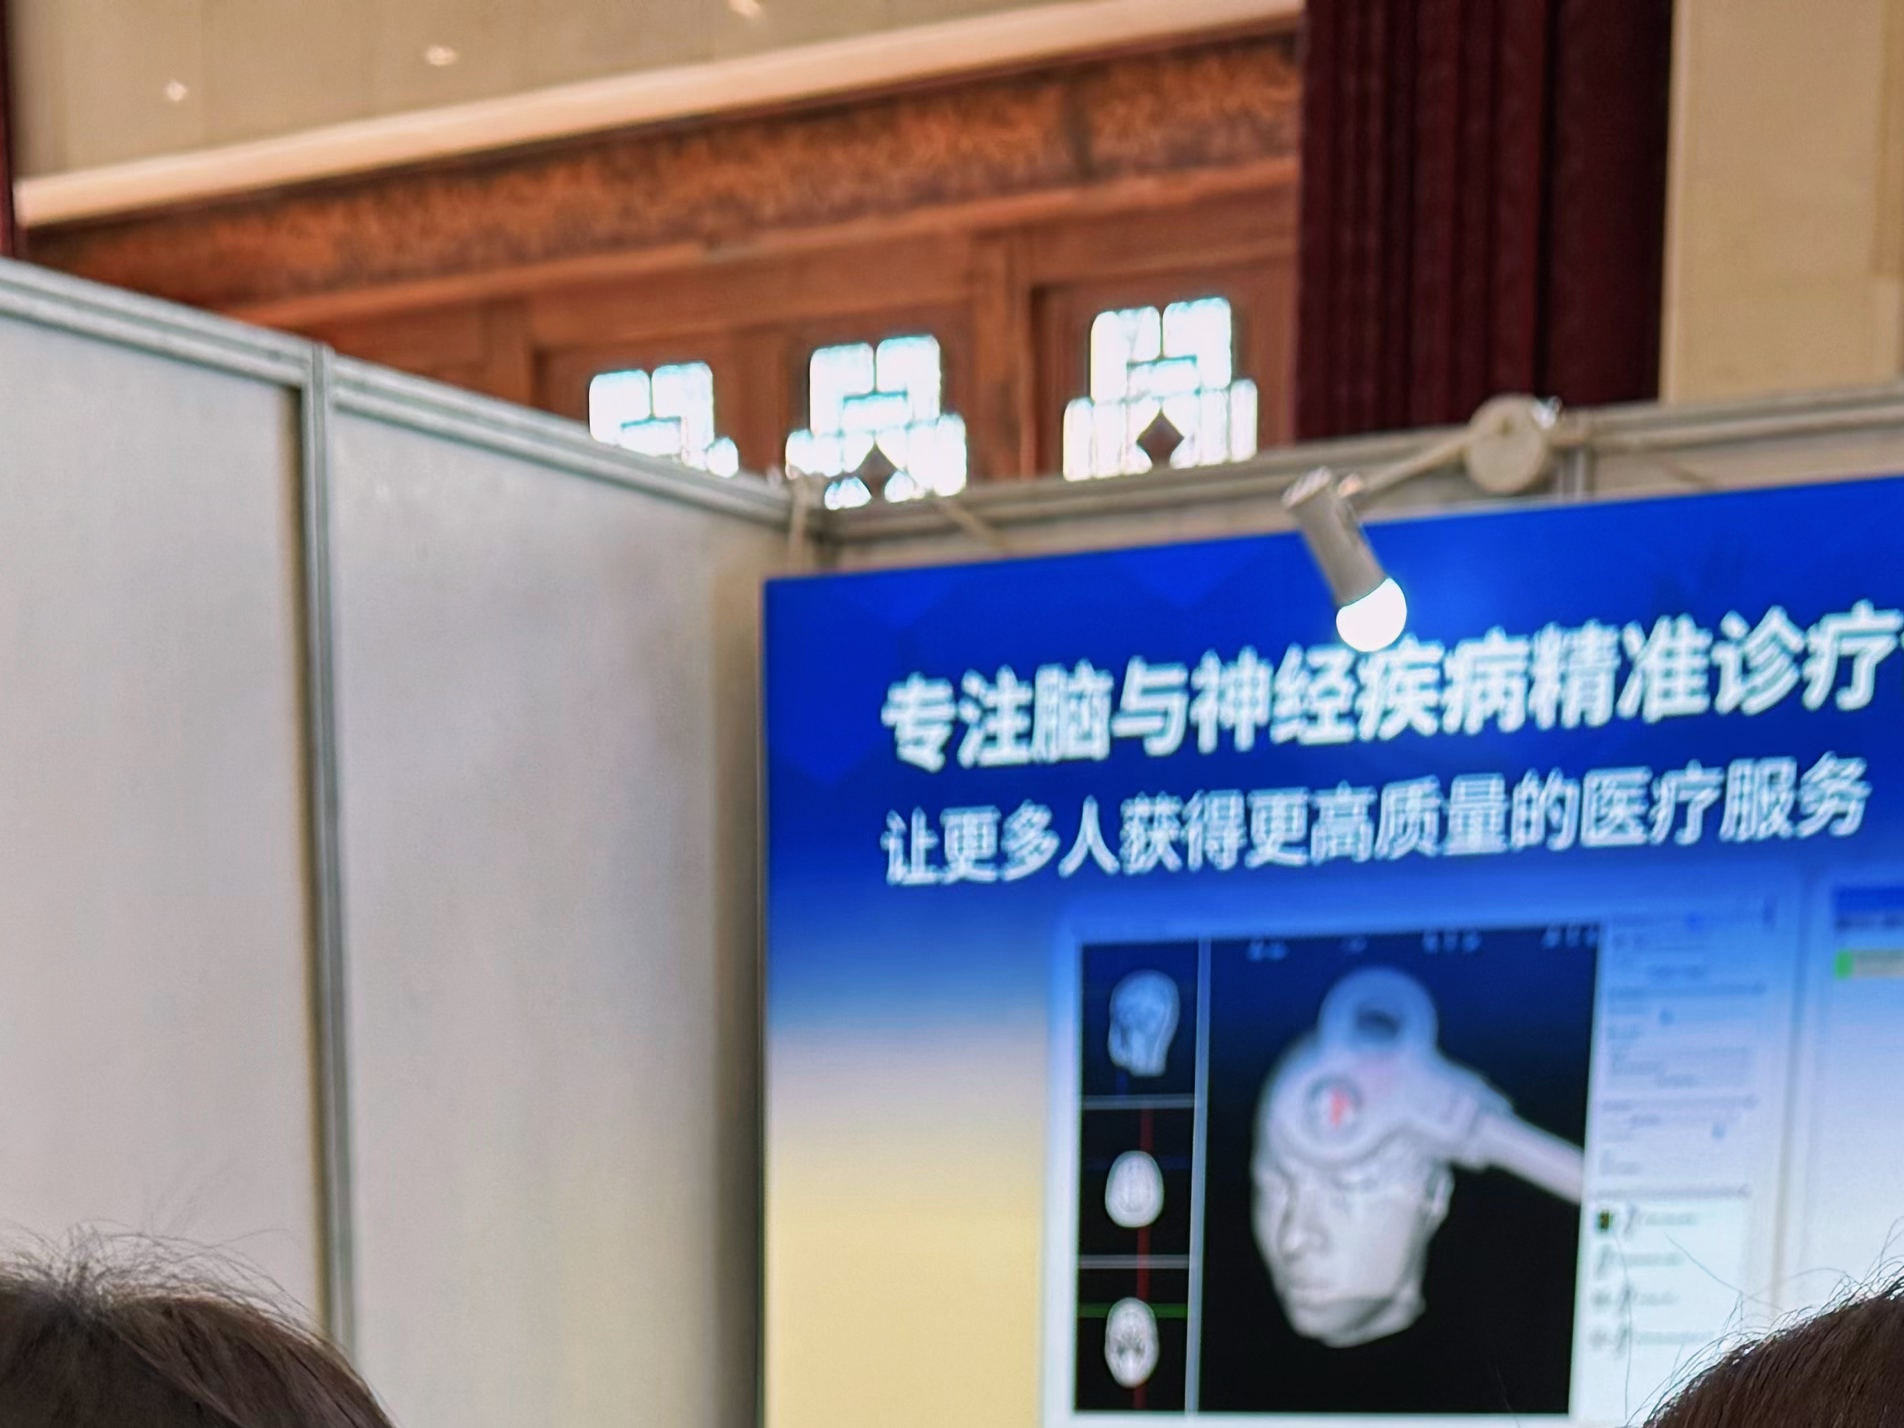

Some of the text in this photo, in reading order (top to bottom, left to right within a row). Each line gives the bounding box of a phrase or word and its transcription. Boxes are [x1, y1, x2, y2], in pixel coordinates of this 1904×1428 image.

[880, 751, 1873, 886] 让更多人获得更高质量的医疗服务
